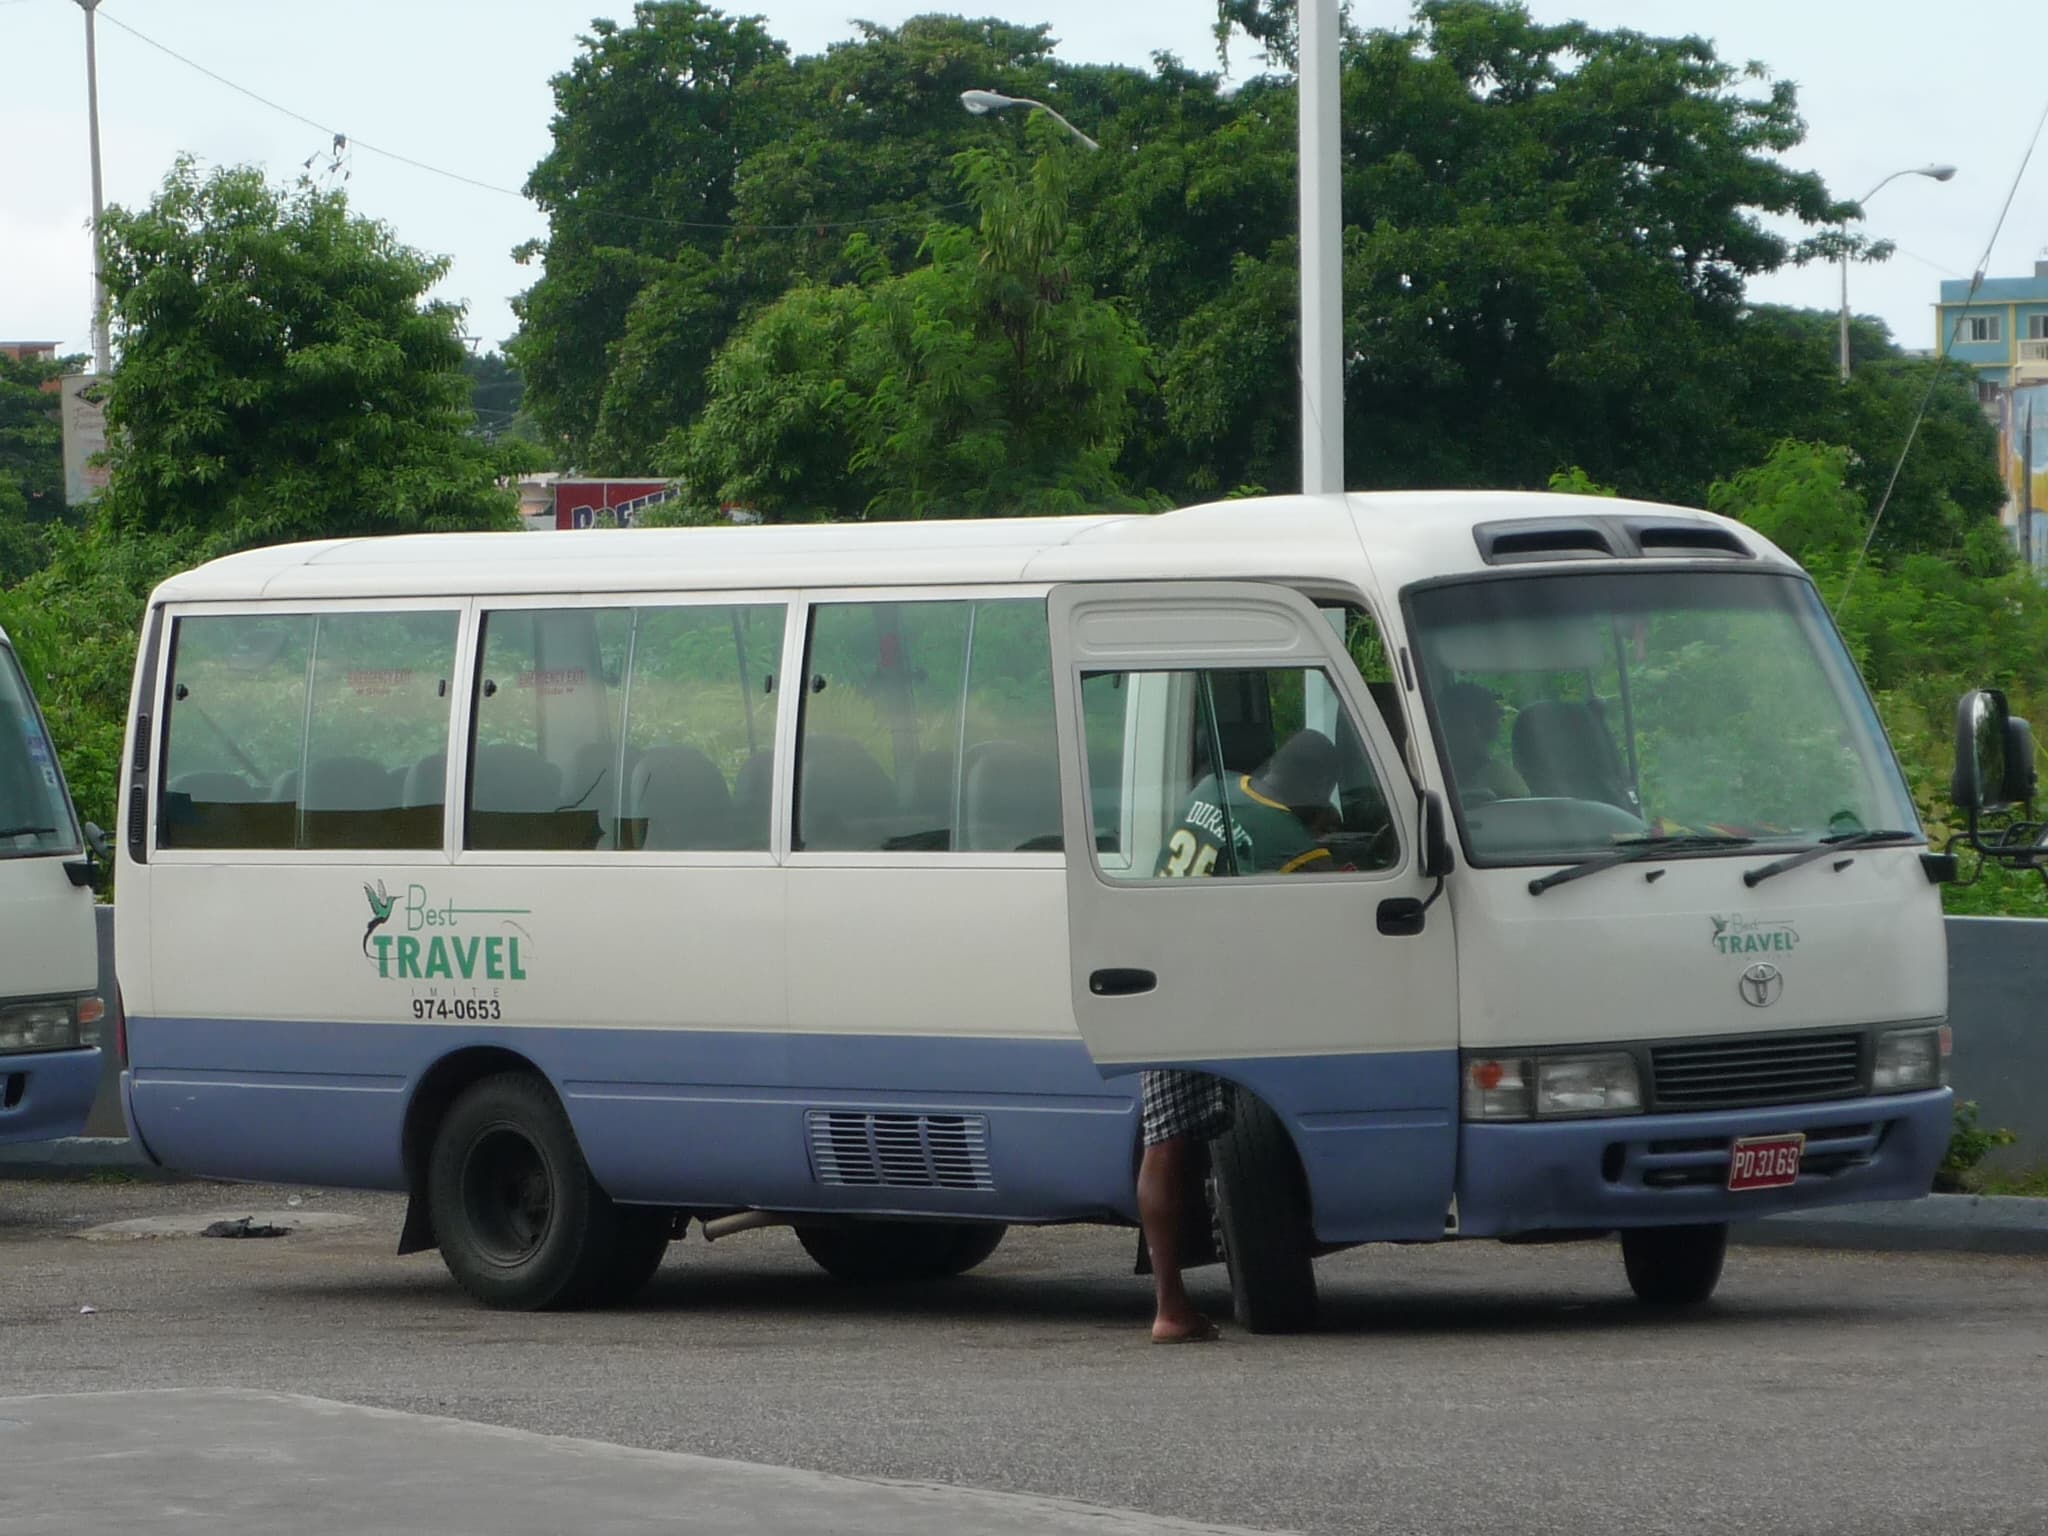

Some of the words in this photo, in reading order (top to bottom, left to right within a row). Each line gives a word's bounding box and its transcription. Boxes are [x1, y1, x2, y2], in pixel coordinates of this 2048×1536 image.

[1717, 931, 1794, 955] TRAVEL
[373, 936, 526, 980] TRAVEL
[412, 999, 501, 1019] 974-0653
